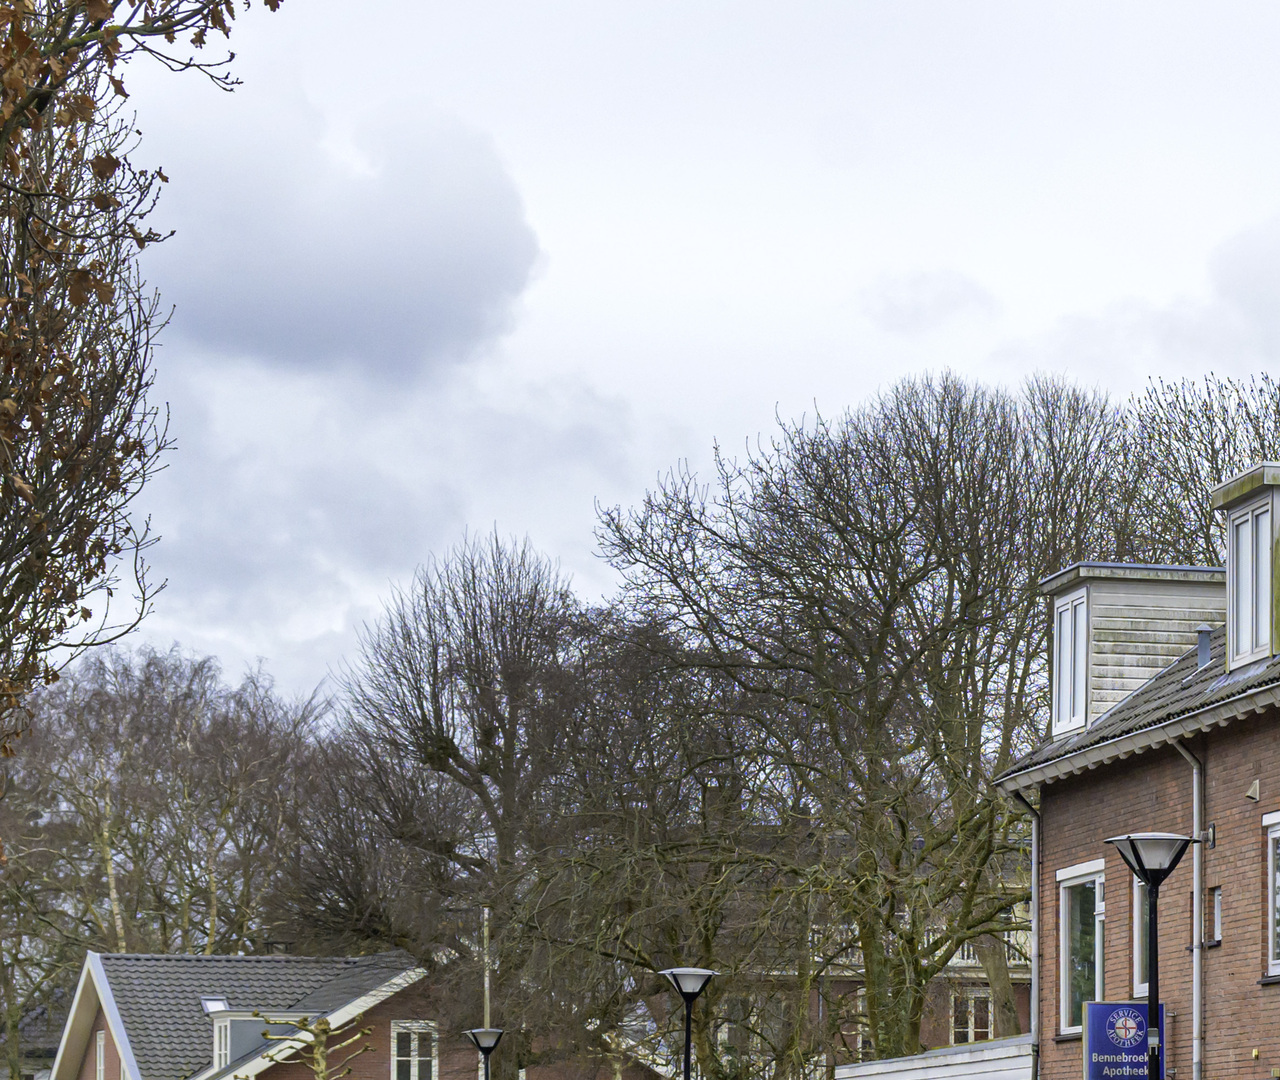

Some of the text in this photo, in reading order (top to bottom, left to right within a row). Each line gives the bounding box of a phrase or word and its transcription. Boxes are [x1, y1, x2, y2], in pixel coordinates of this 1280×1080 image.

[1110, 1009, 1141, 1024] SERVICE
[1107, 1029, 1144, 1048] APOTHEEK
[1092, 1052, 1149, 1063] Bennebroek
[1102, 1065, 1149, 1078] Apotheek
